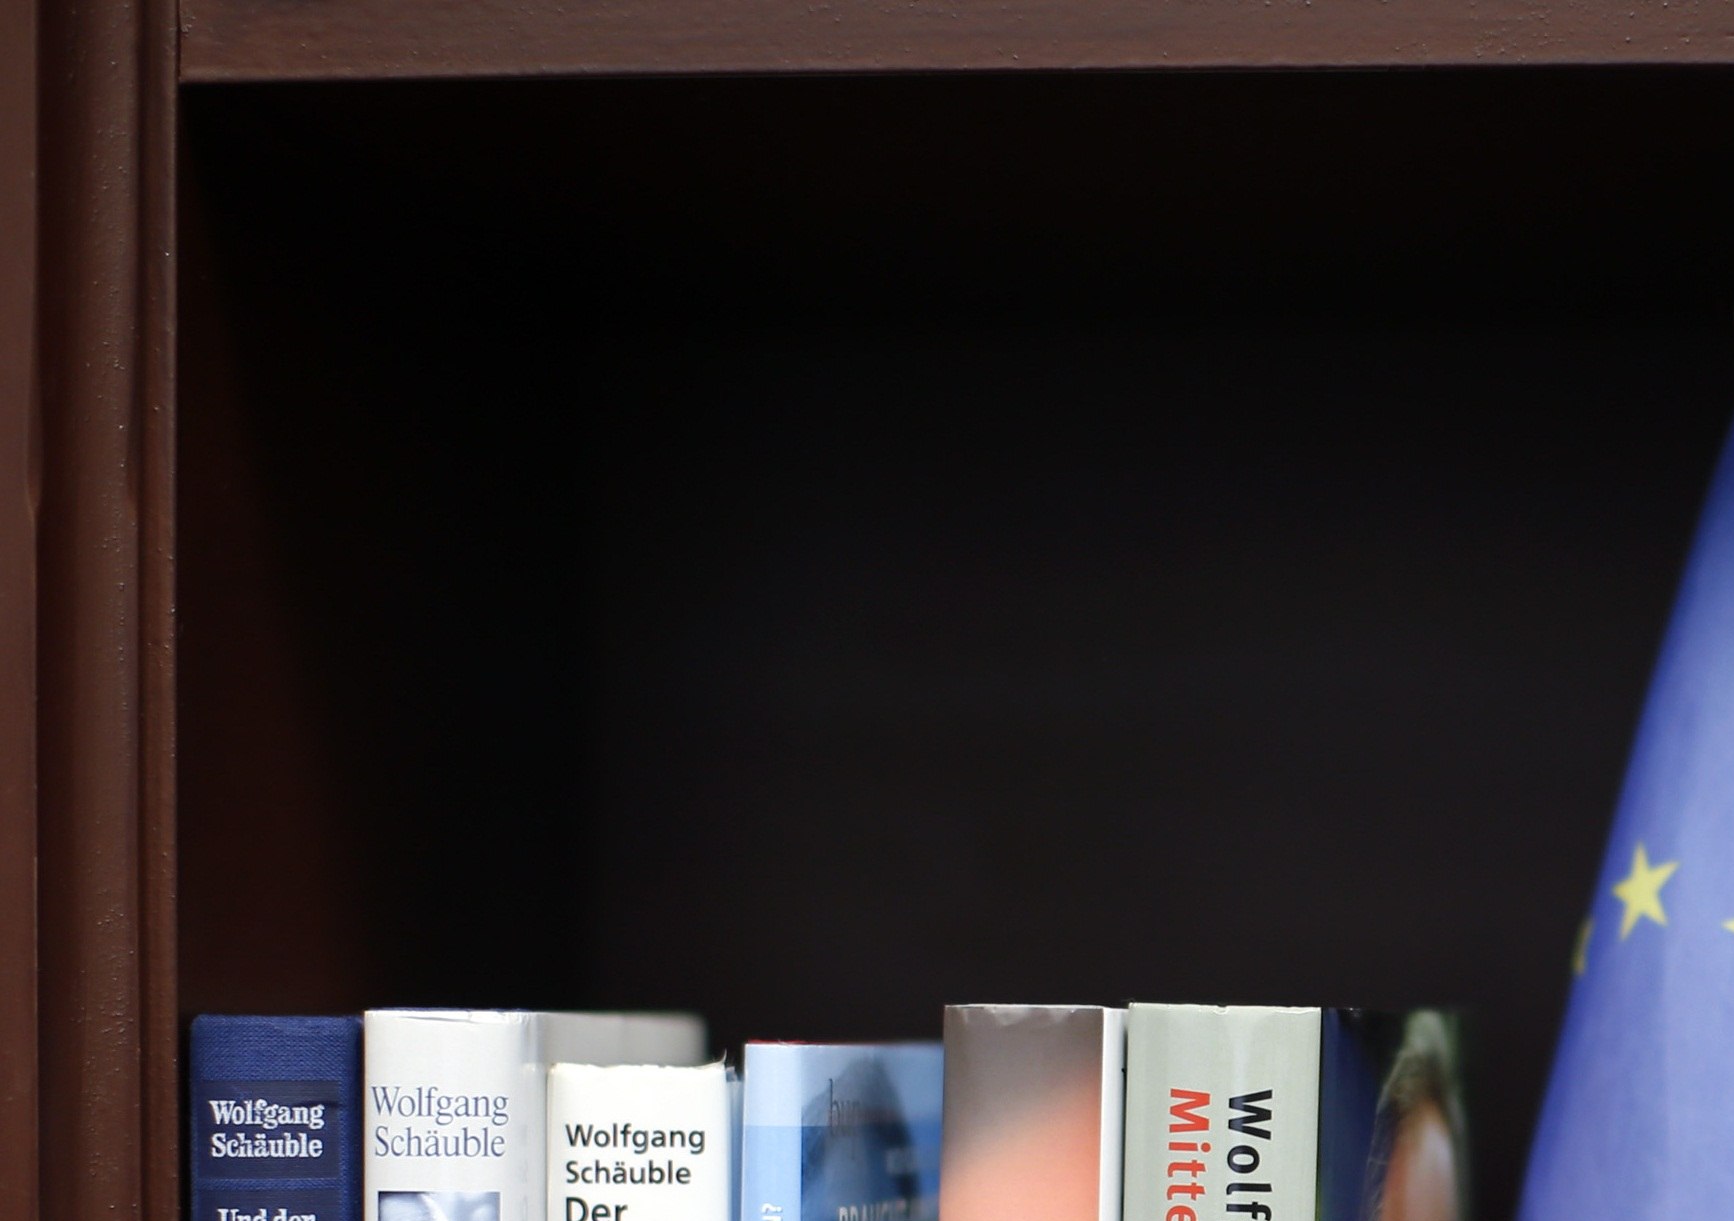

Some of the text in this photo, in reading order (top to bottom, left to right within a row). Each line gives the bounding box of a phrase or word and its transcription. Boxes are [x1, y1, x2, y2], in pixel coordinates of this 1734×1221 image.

[210, 1099, 325, 1129] Wolfgang
[371, 1086, 508, 1124] Wolfgang
[211, 1134, 323, 1158] Schäuble
[374, 1126, 505, 1158] Schäuble
[566, 1123, 705, 1153] Wolfgang
[566, 1161, 691, 1184] Schäuble
